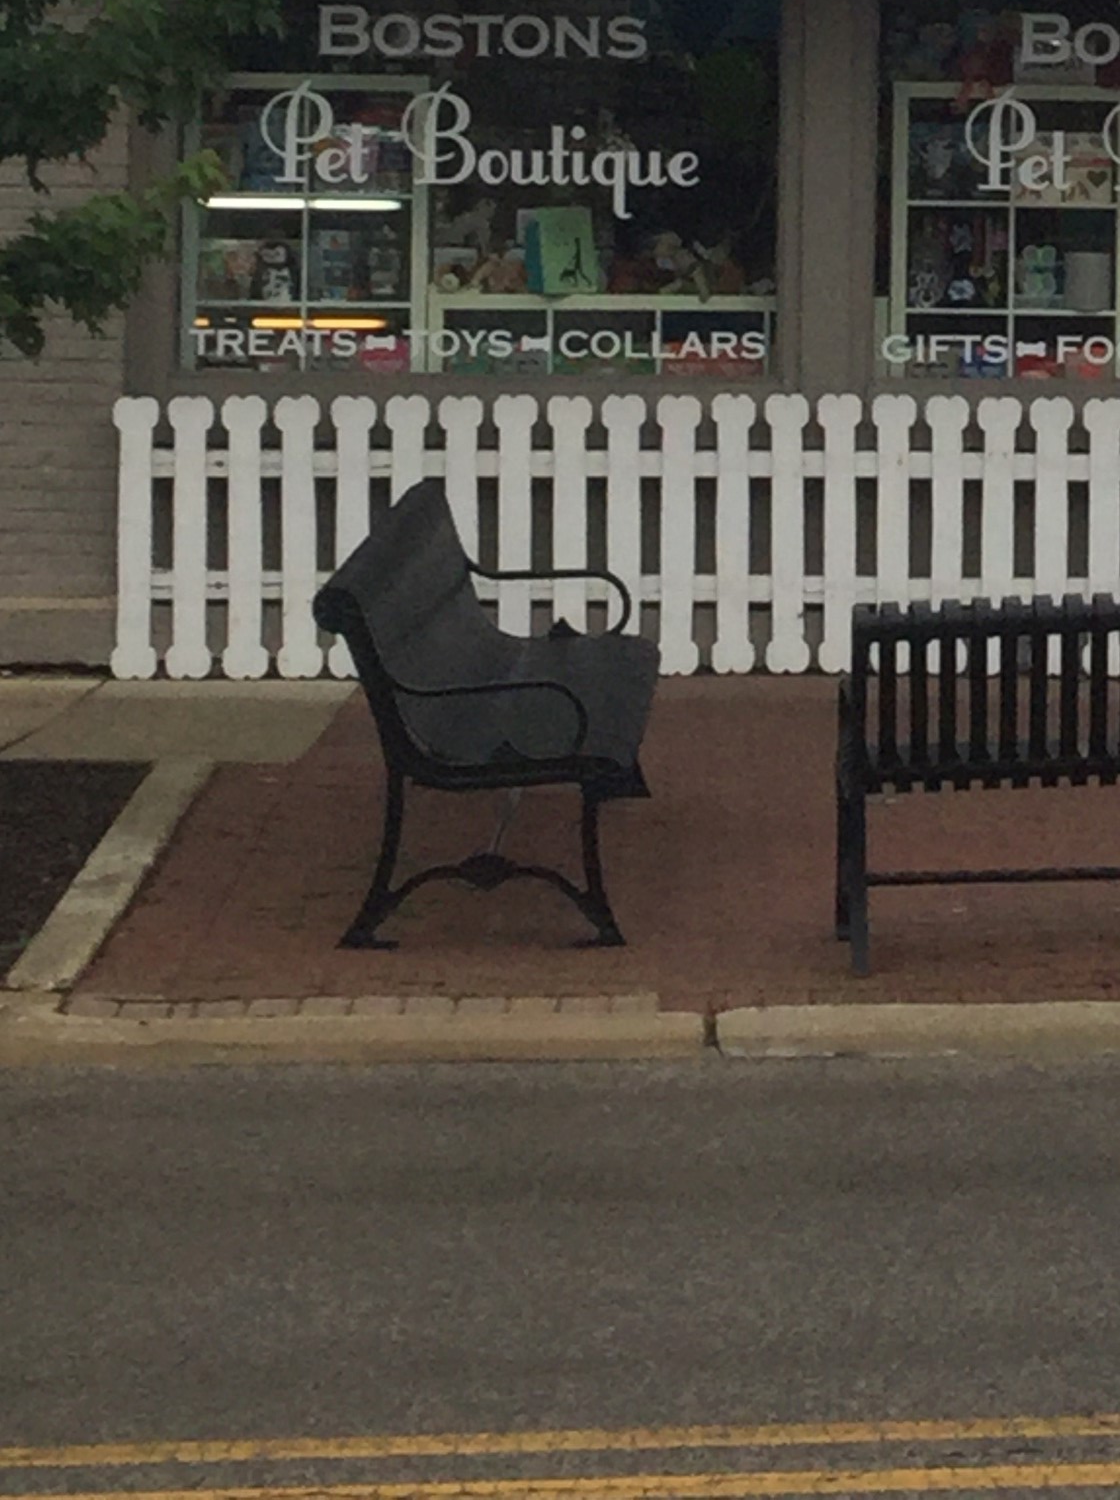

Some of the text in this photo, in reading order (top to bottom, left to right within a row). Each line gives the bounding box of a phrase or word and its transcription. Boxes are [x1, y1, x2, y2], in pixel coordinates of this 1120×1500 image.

[318, 4, 648, 59] BOSTONS
[261, 79, 700, 219] Pet Boutique
[965, 86, 1072, 192] Pet
[189, 329, 766, 360] TREATS TOYS COLLARS
[881, 335, 1008, 365] GIFTS
